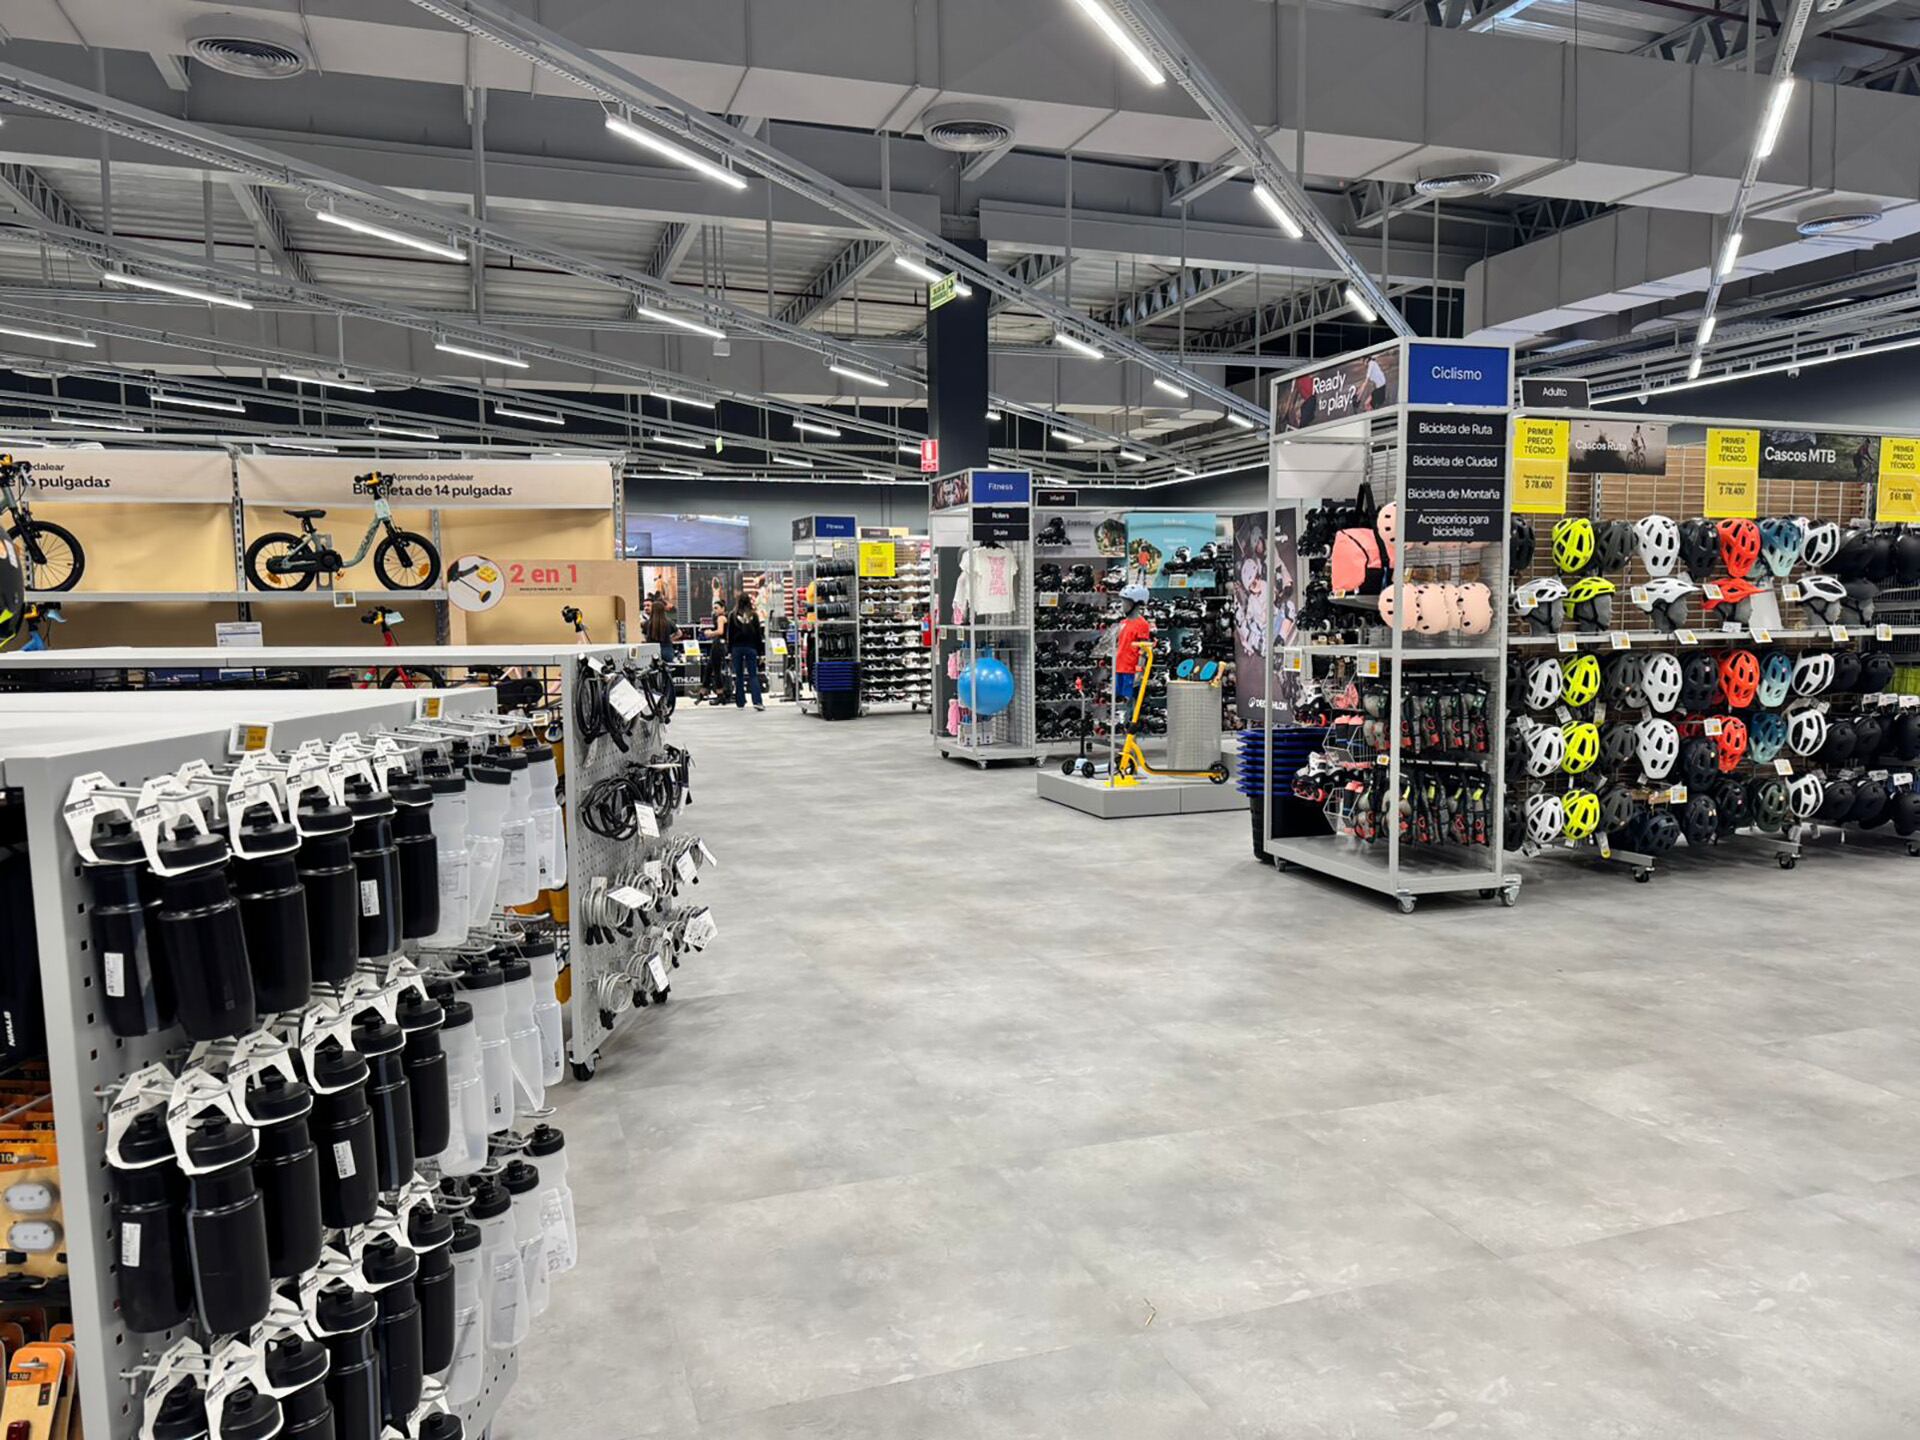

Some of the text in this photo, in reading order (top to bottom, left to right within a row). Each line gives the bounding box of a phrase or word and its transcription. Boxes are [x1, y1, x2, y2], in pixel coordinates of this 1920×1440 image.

[1431, 365, 1482, 381] Ciclismo
[1312, 371, 1346, 395] Ready
[1542, 387, 1568, 397] Adulto
[1319, 385, 1356, 416] to play?
[1419, 422, 1493, 435] Bicicleta de Ruta
[1527, 427, 1554, 435] PRIMER
[1527, 437, 1553, 445] PRECIO
[1575, 439, 1627, 451] Cascos Ruta
[1721, 436, 1745, 444] PRIMER
[1524, 445, 1556, 454] TÉCNICO
[1764, 446, 1836, 464] Cascos MTB
[1412, 455, 1498, 467] Bicicleta de Ciudad
[1718, 453, 1747, 462] TÉCNICO
[39, 476, 111, 490] pulgadas
[391, 473, 429, 482] Aprendo
[437, 473, 474, 482] pedalear
[988, 482, 1013, 491] Fitness
[1525, 479, 1530, 489] $
[415, 485, 432, 496] de
[435, 485, 450, 495] 14
[452, 485, 513, 498] pulgadas
[1407, 488, 1500, 499] Bicicleta de Montaña
[1417, 514, 1489, 527] Accesorios para
[1432, 526, 1475, 537] bicicletas
[509, 564, 577, 583] 2 en 1
